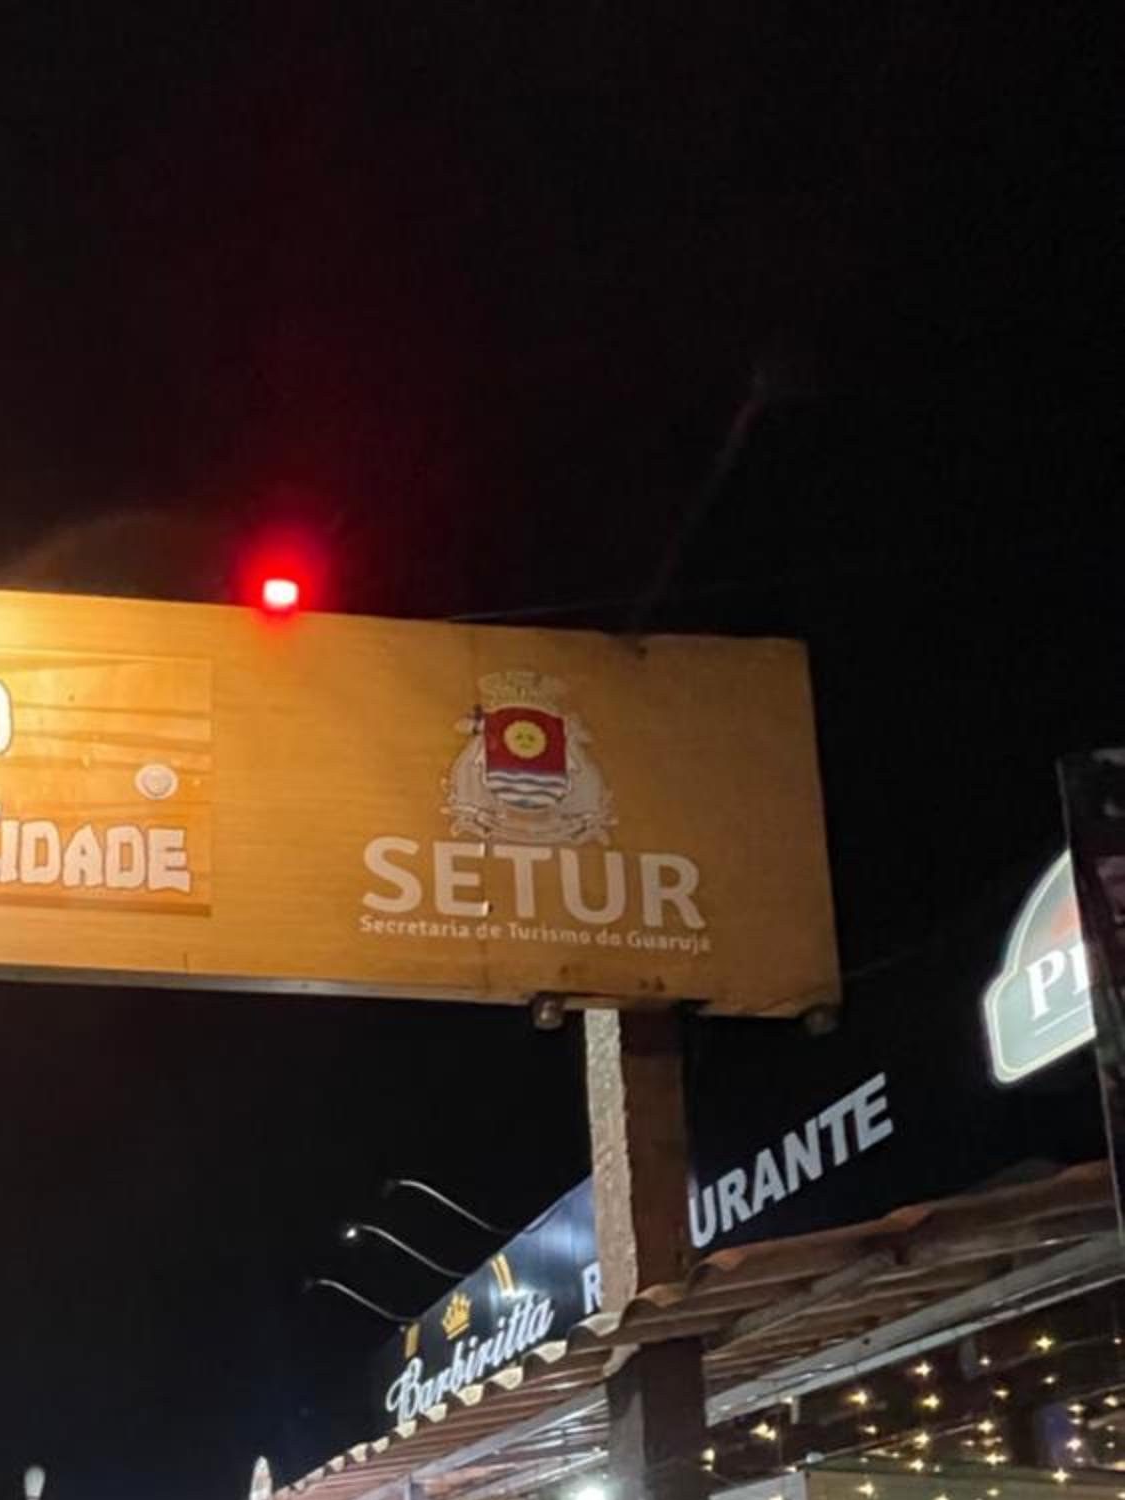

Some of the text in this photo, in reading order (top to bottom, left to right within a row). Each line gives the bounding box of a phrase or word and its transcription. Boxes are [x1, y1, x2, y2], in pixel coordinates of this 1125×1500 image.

[362, 836, 706, 929] SETUR
[360, 914, 470, 940] Secretaria
[475, 921, 502, 940] de
[508, 922, 590, 947] Turismo
